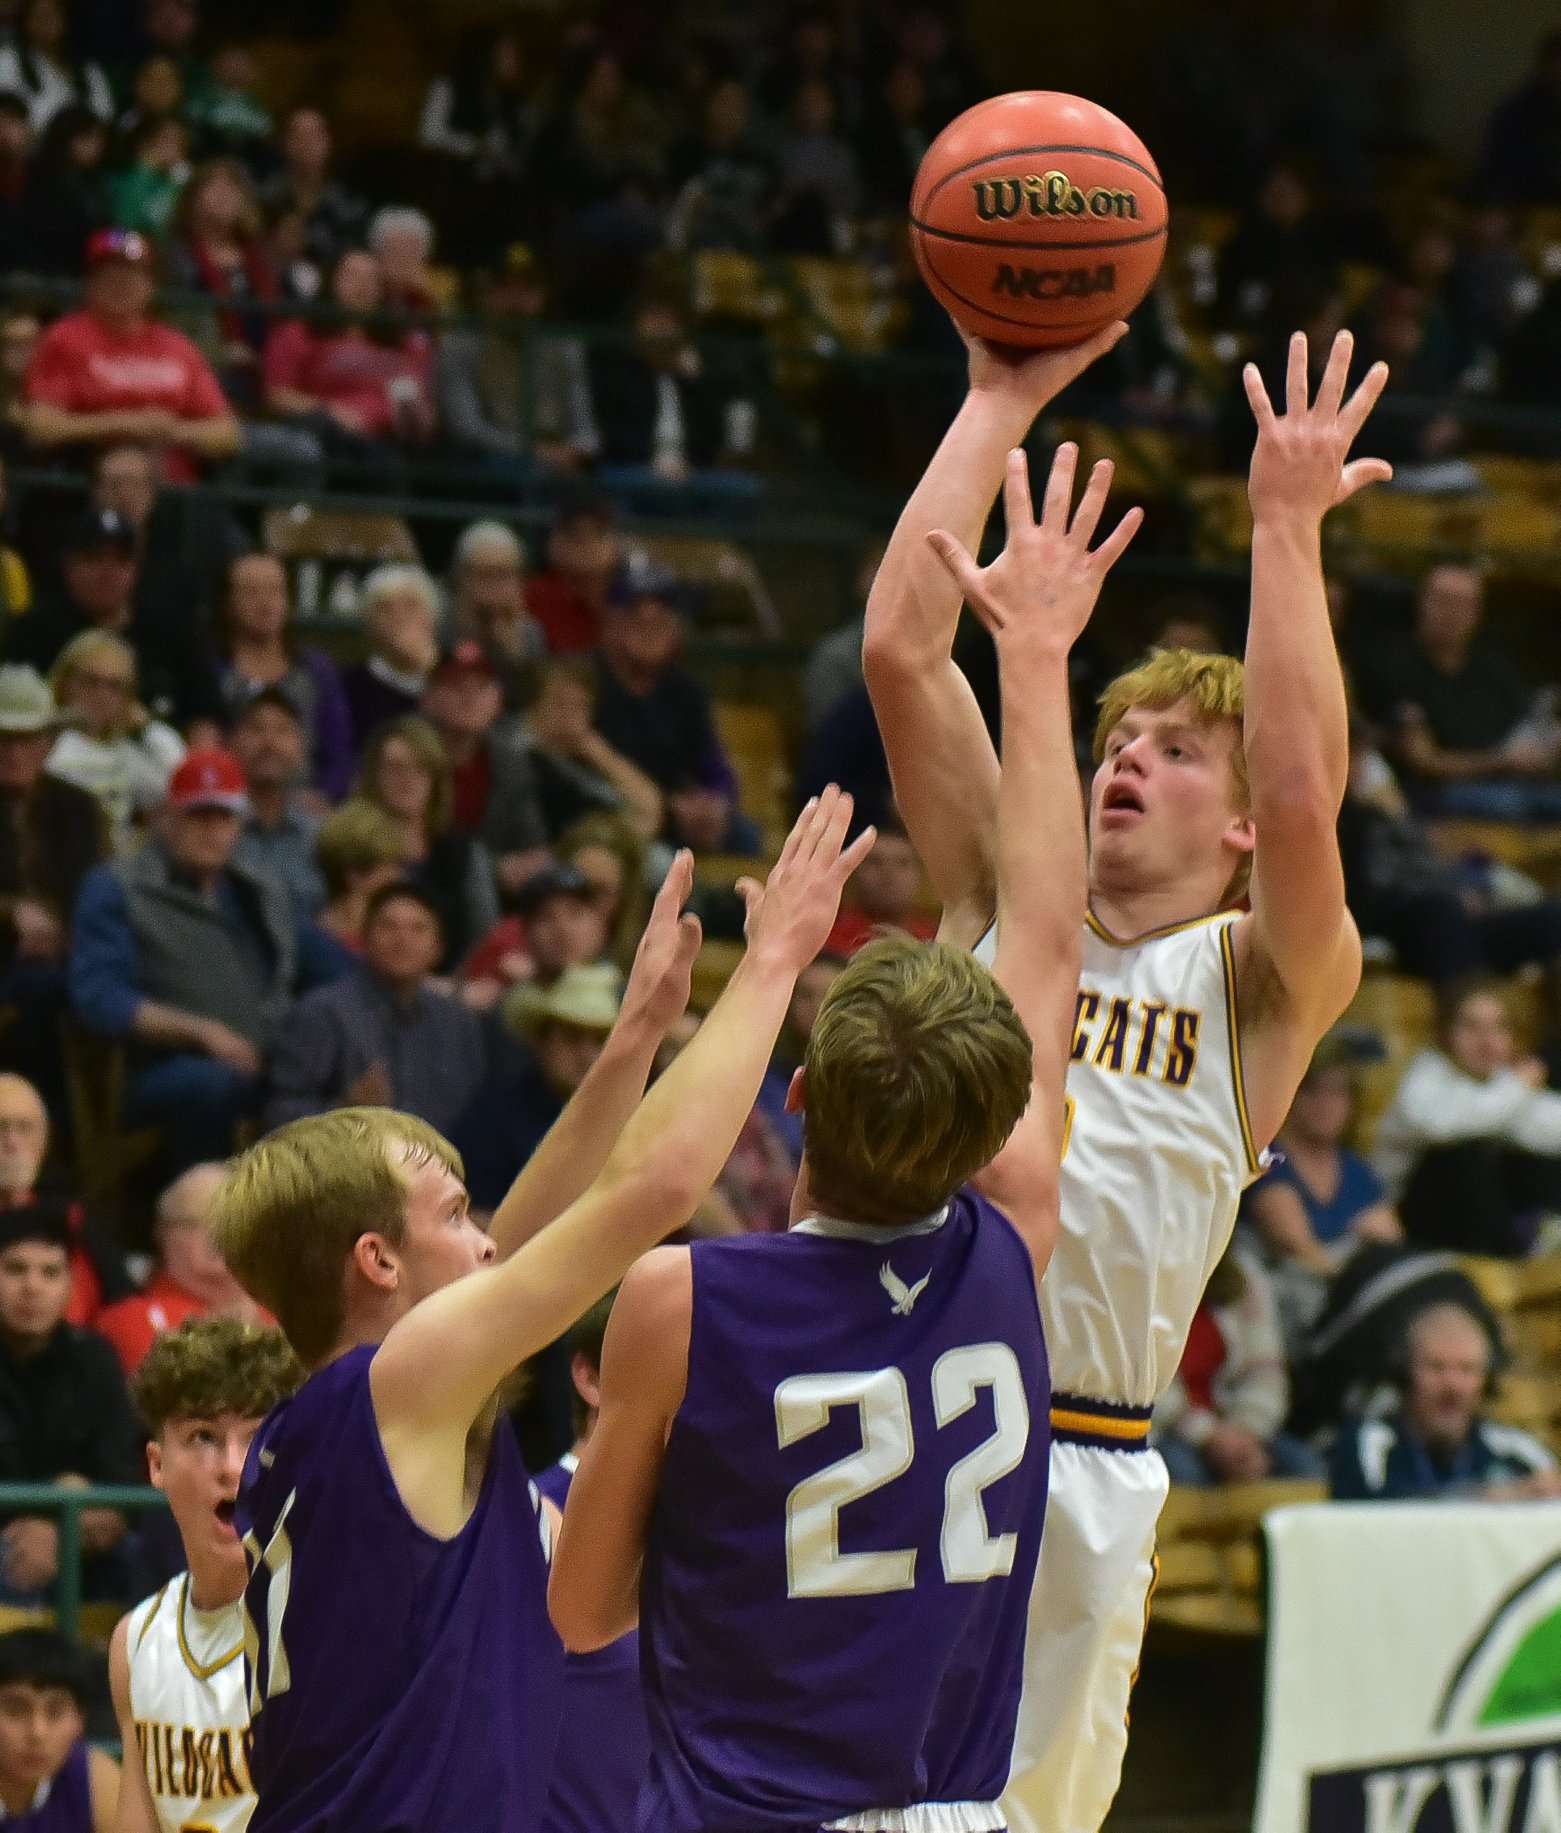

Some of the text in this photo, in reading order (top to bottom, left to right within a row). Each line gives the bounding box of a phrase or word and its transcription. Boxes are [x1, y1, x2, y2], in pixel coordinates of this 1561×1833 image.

[973, 170, 1141, 222] Wilson
[992, 263, 1116, 298] NCAA
[774, 1342, 1030, 1599] 22
